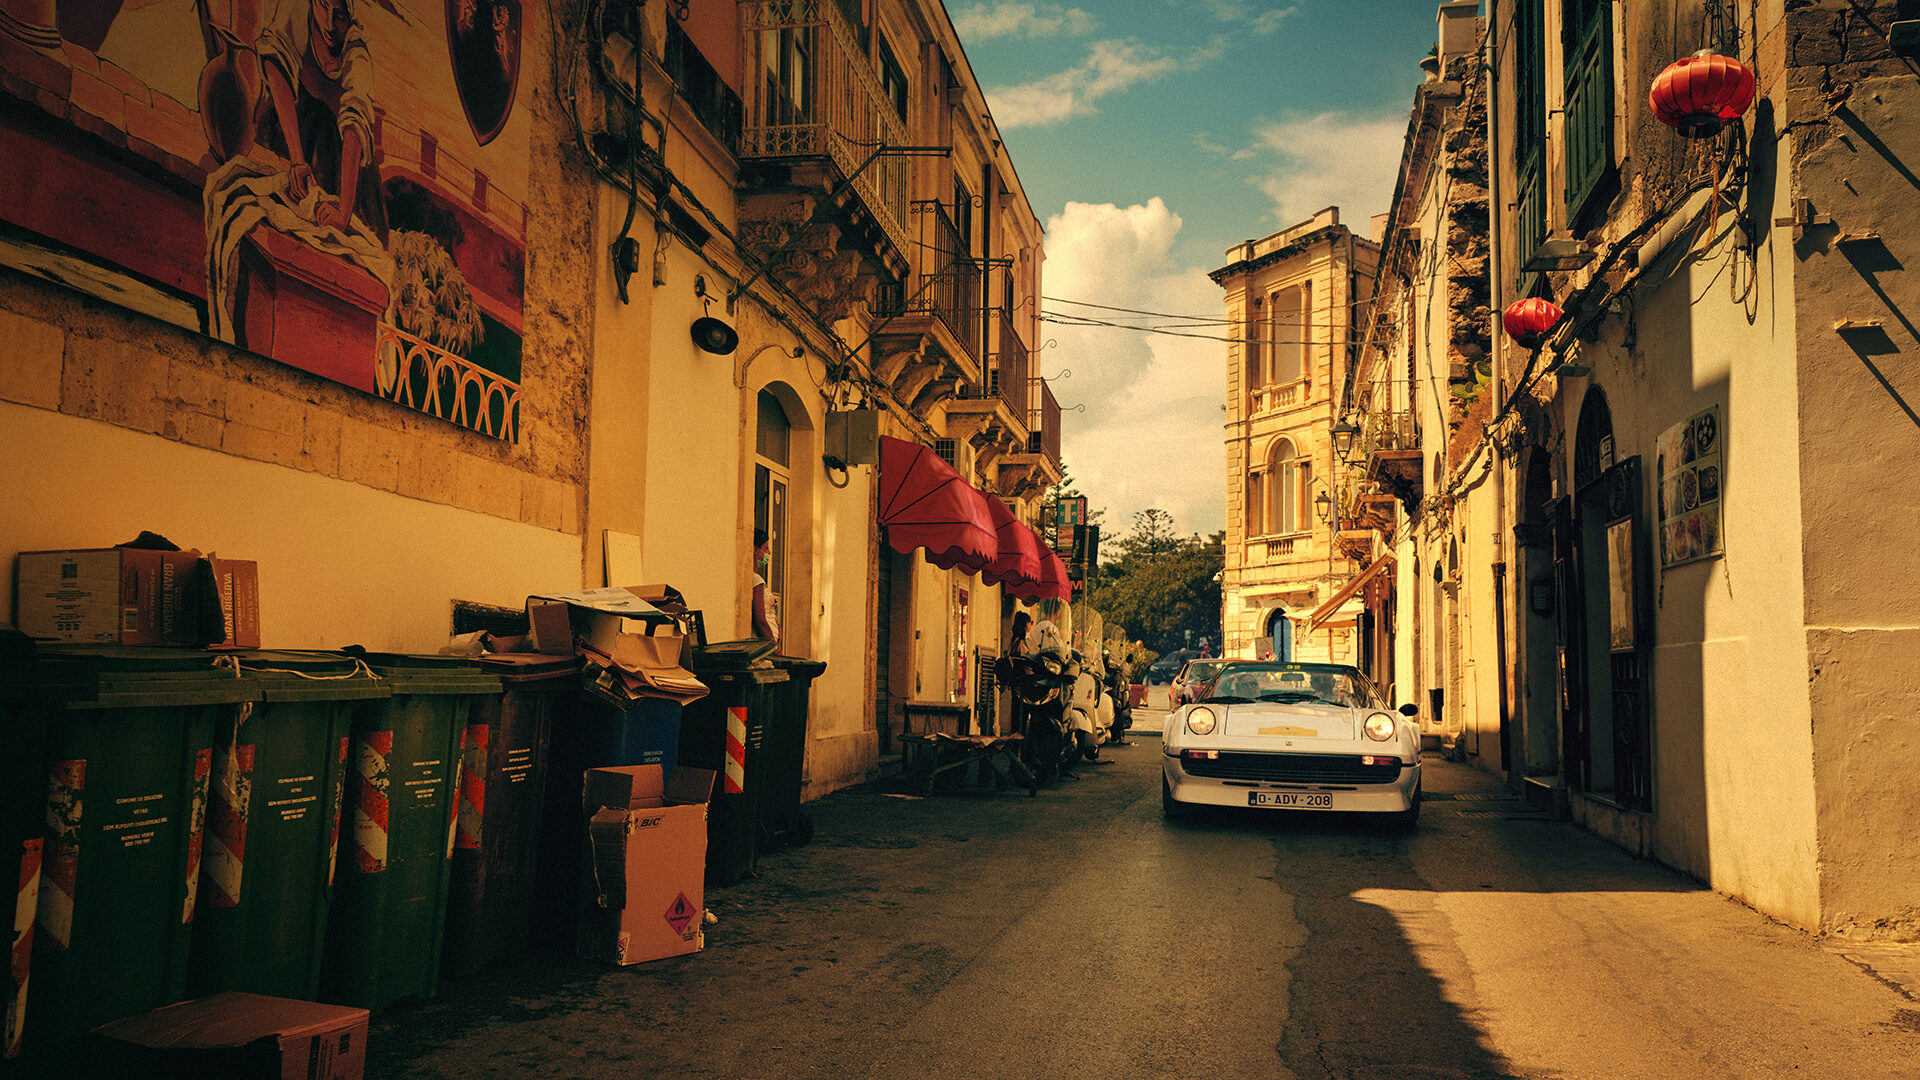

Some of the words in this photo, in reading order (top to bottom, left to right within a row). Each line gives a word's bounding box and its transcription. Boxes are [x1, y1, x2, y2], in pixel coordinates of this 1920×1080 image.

[163, 563, 174, 591] GRAN
[224, 573, 233, 611] RISERVA
[163, 593, 174, 634] RISERVA
[224, 613, 233, 639] GRAN
[640, 817, 662, 827] BIC
